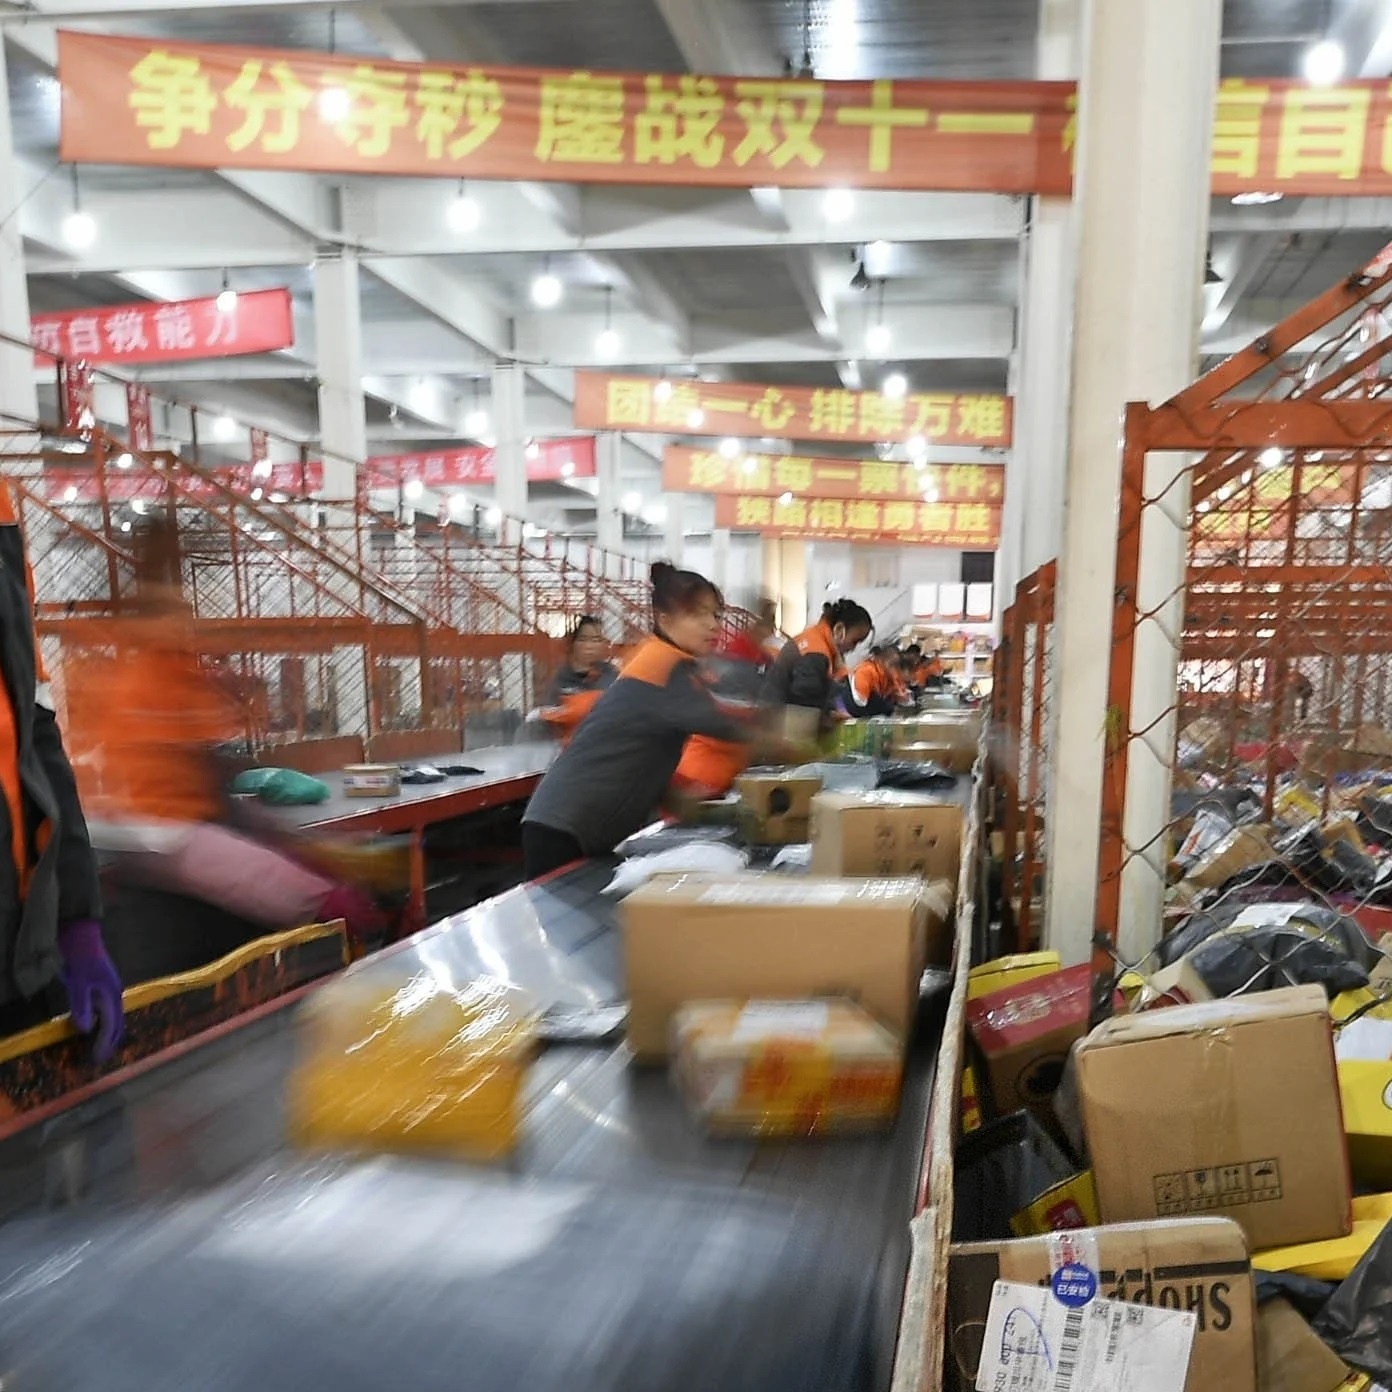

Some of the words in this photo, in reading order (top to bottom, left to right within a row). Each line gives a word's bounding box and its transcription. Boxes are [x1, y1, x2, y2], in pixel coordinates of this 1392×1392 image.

[128, 49, 506, 163] 争分夺秒
[533, 71, 1034, 174] 鏖战双十一
[605, 379, 795, 429] 团结一心
[808, 391, 1005, 440] 排除万难
